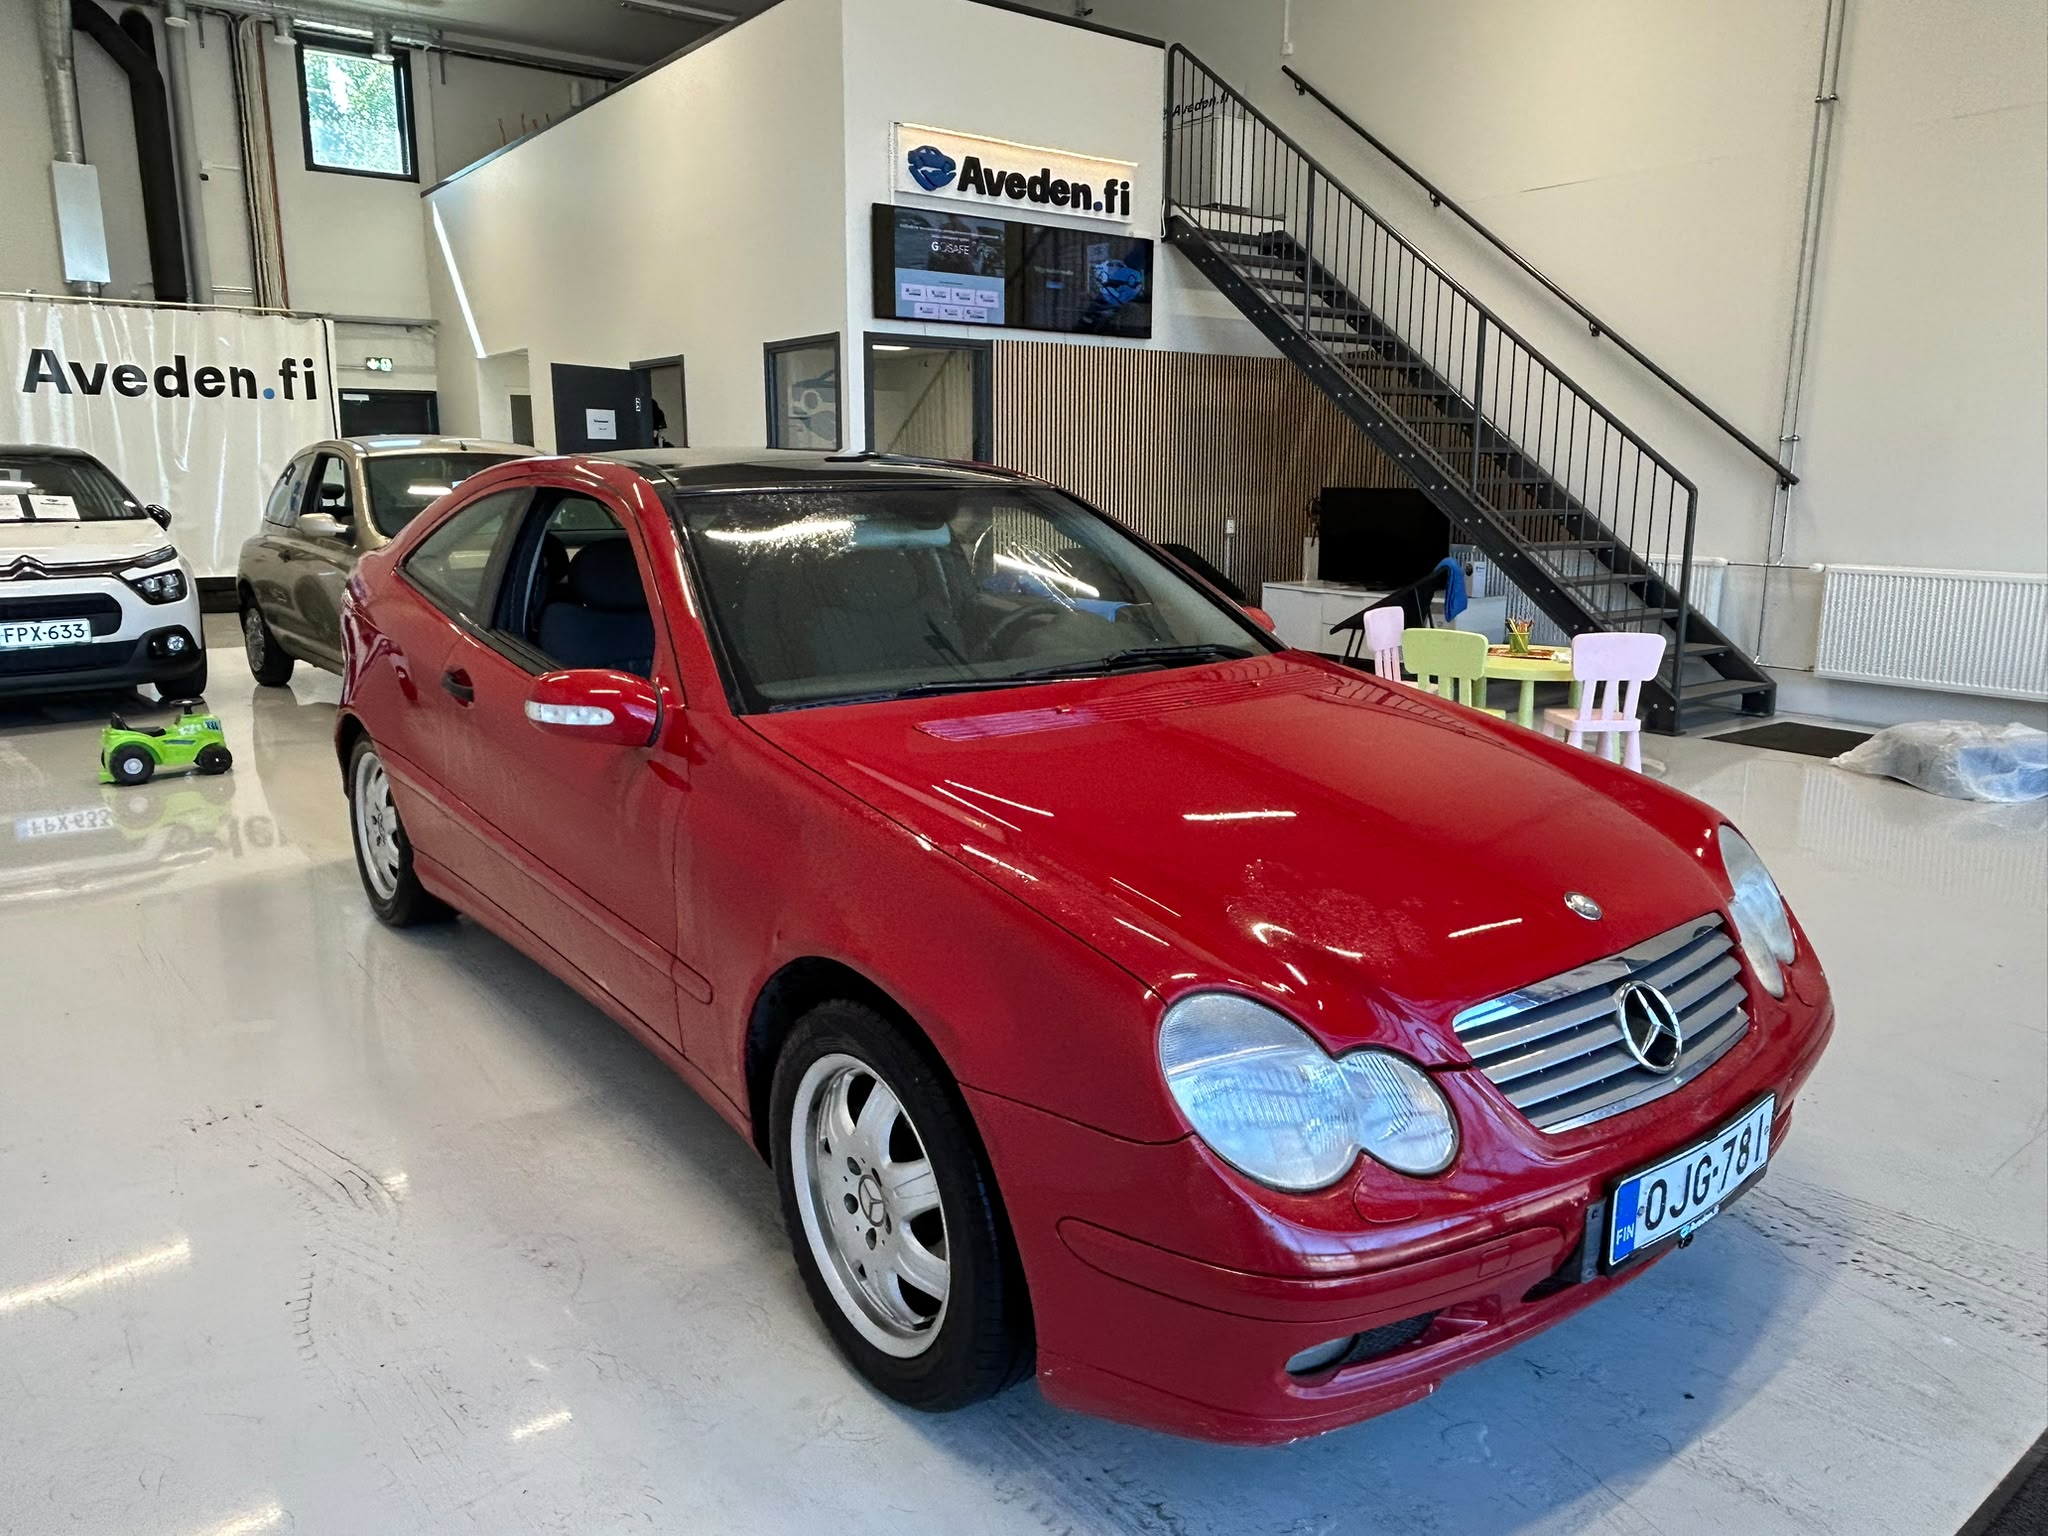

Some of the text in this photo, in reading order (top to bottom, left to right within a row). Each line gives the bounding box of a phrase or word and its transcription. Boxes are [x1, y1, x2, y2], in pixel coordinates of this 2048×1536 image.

[957, 156, 1130, 216] Aveden.fi
[22, 348, 318, 400] Aveden.fi
[3, 623, 85, 643] FPX-633
[1644, 1113, 1764, 1231] OJG-781
[1615, 1222, 1635, 1246] FIN
